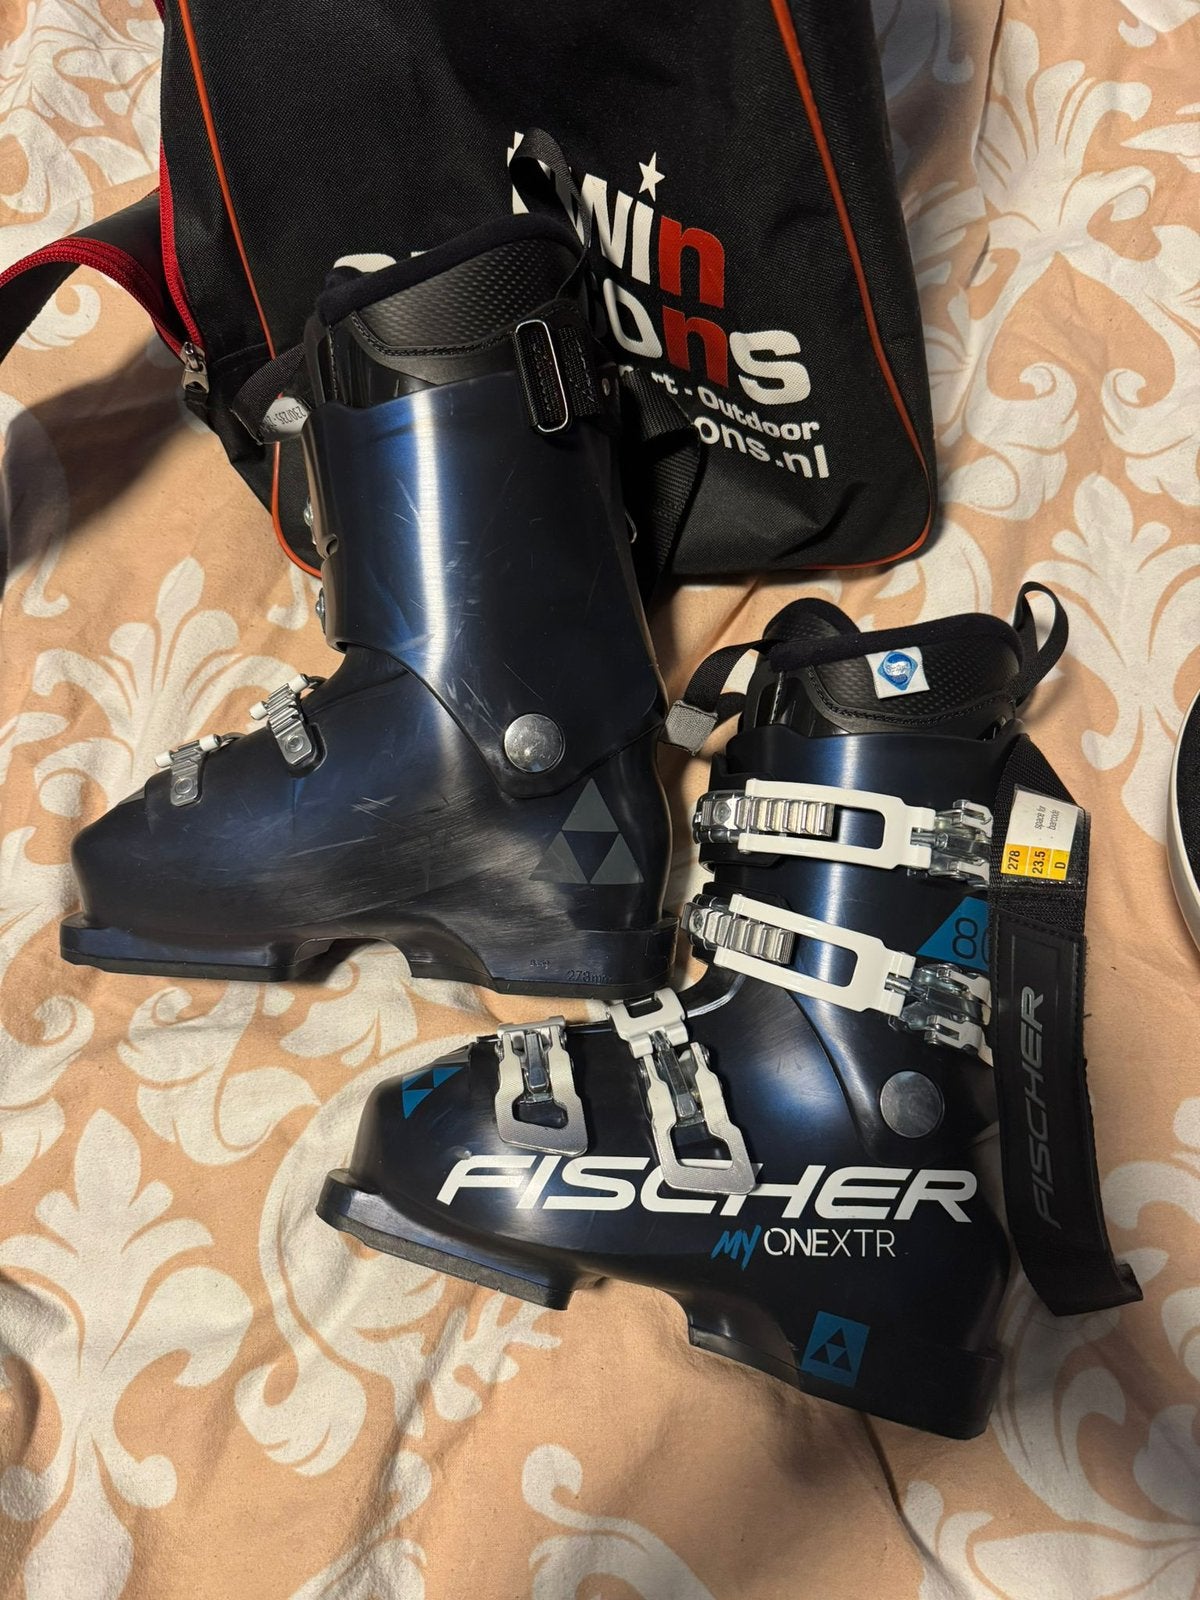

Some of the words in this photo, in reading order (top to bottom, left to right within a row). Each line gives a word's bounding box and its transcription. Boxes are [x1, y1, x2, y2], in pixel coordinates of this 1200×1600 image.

[697, 386, 820, 441] Outdoor
[694, 416, 829, 478] ons.nl
[1034, 812, 1045, 830] space
[1007, 850, 1020, 871] 278
[1032, 850, 1046, 874] 23.5
[1054, 861, 1066, 870] D
[1020, 985, 1062, 1231] FISCHER
[436, 1155, 977, 1224] FISCHER
